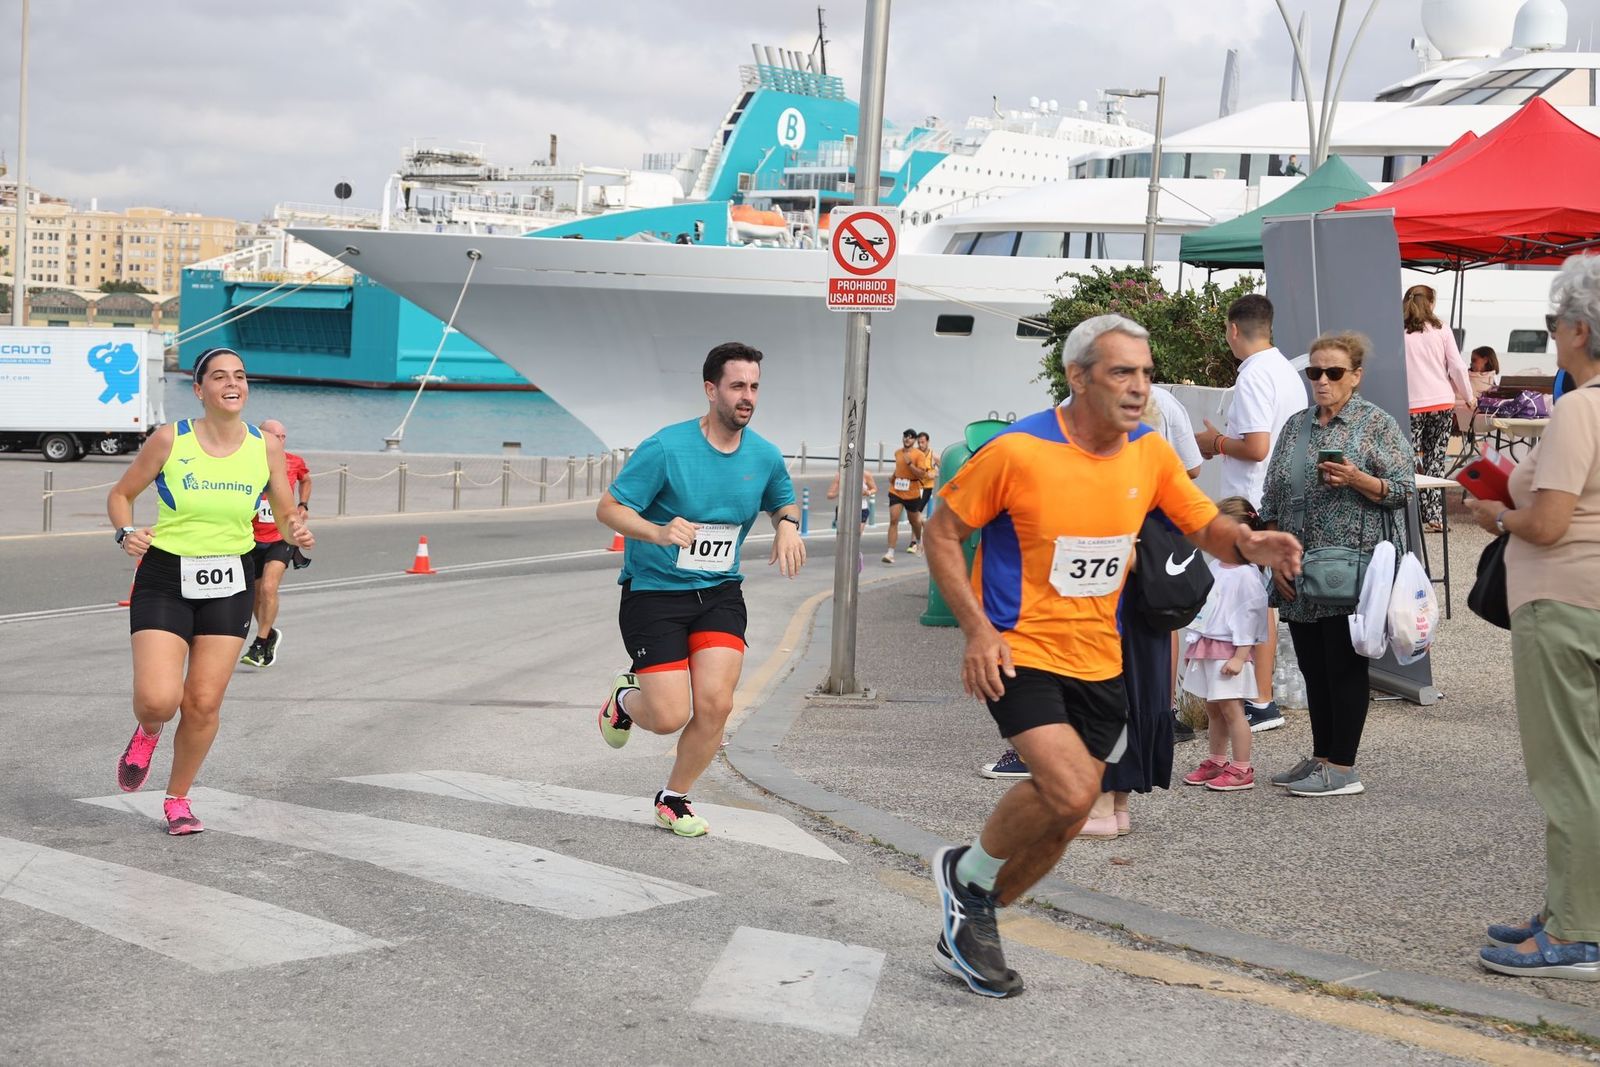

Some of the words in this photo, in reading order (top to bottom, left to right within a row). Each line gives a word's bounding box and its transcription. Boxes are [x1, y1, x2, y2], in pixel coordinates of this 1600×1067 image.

[785, 113, 798, 140] B
[837, 281, 887, 290] PROHIBIDO
[830, 293, 854, 303] USAR
[857, 293, 894, 303] DRONES
[1, 345, 51, 354] CAUTO
[202, 480, 252, 495] Running
[690, 540, 732, 556] 1077
[1069, 557, 1119, 579] 376
[196, 567, 233, 585] 601
